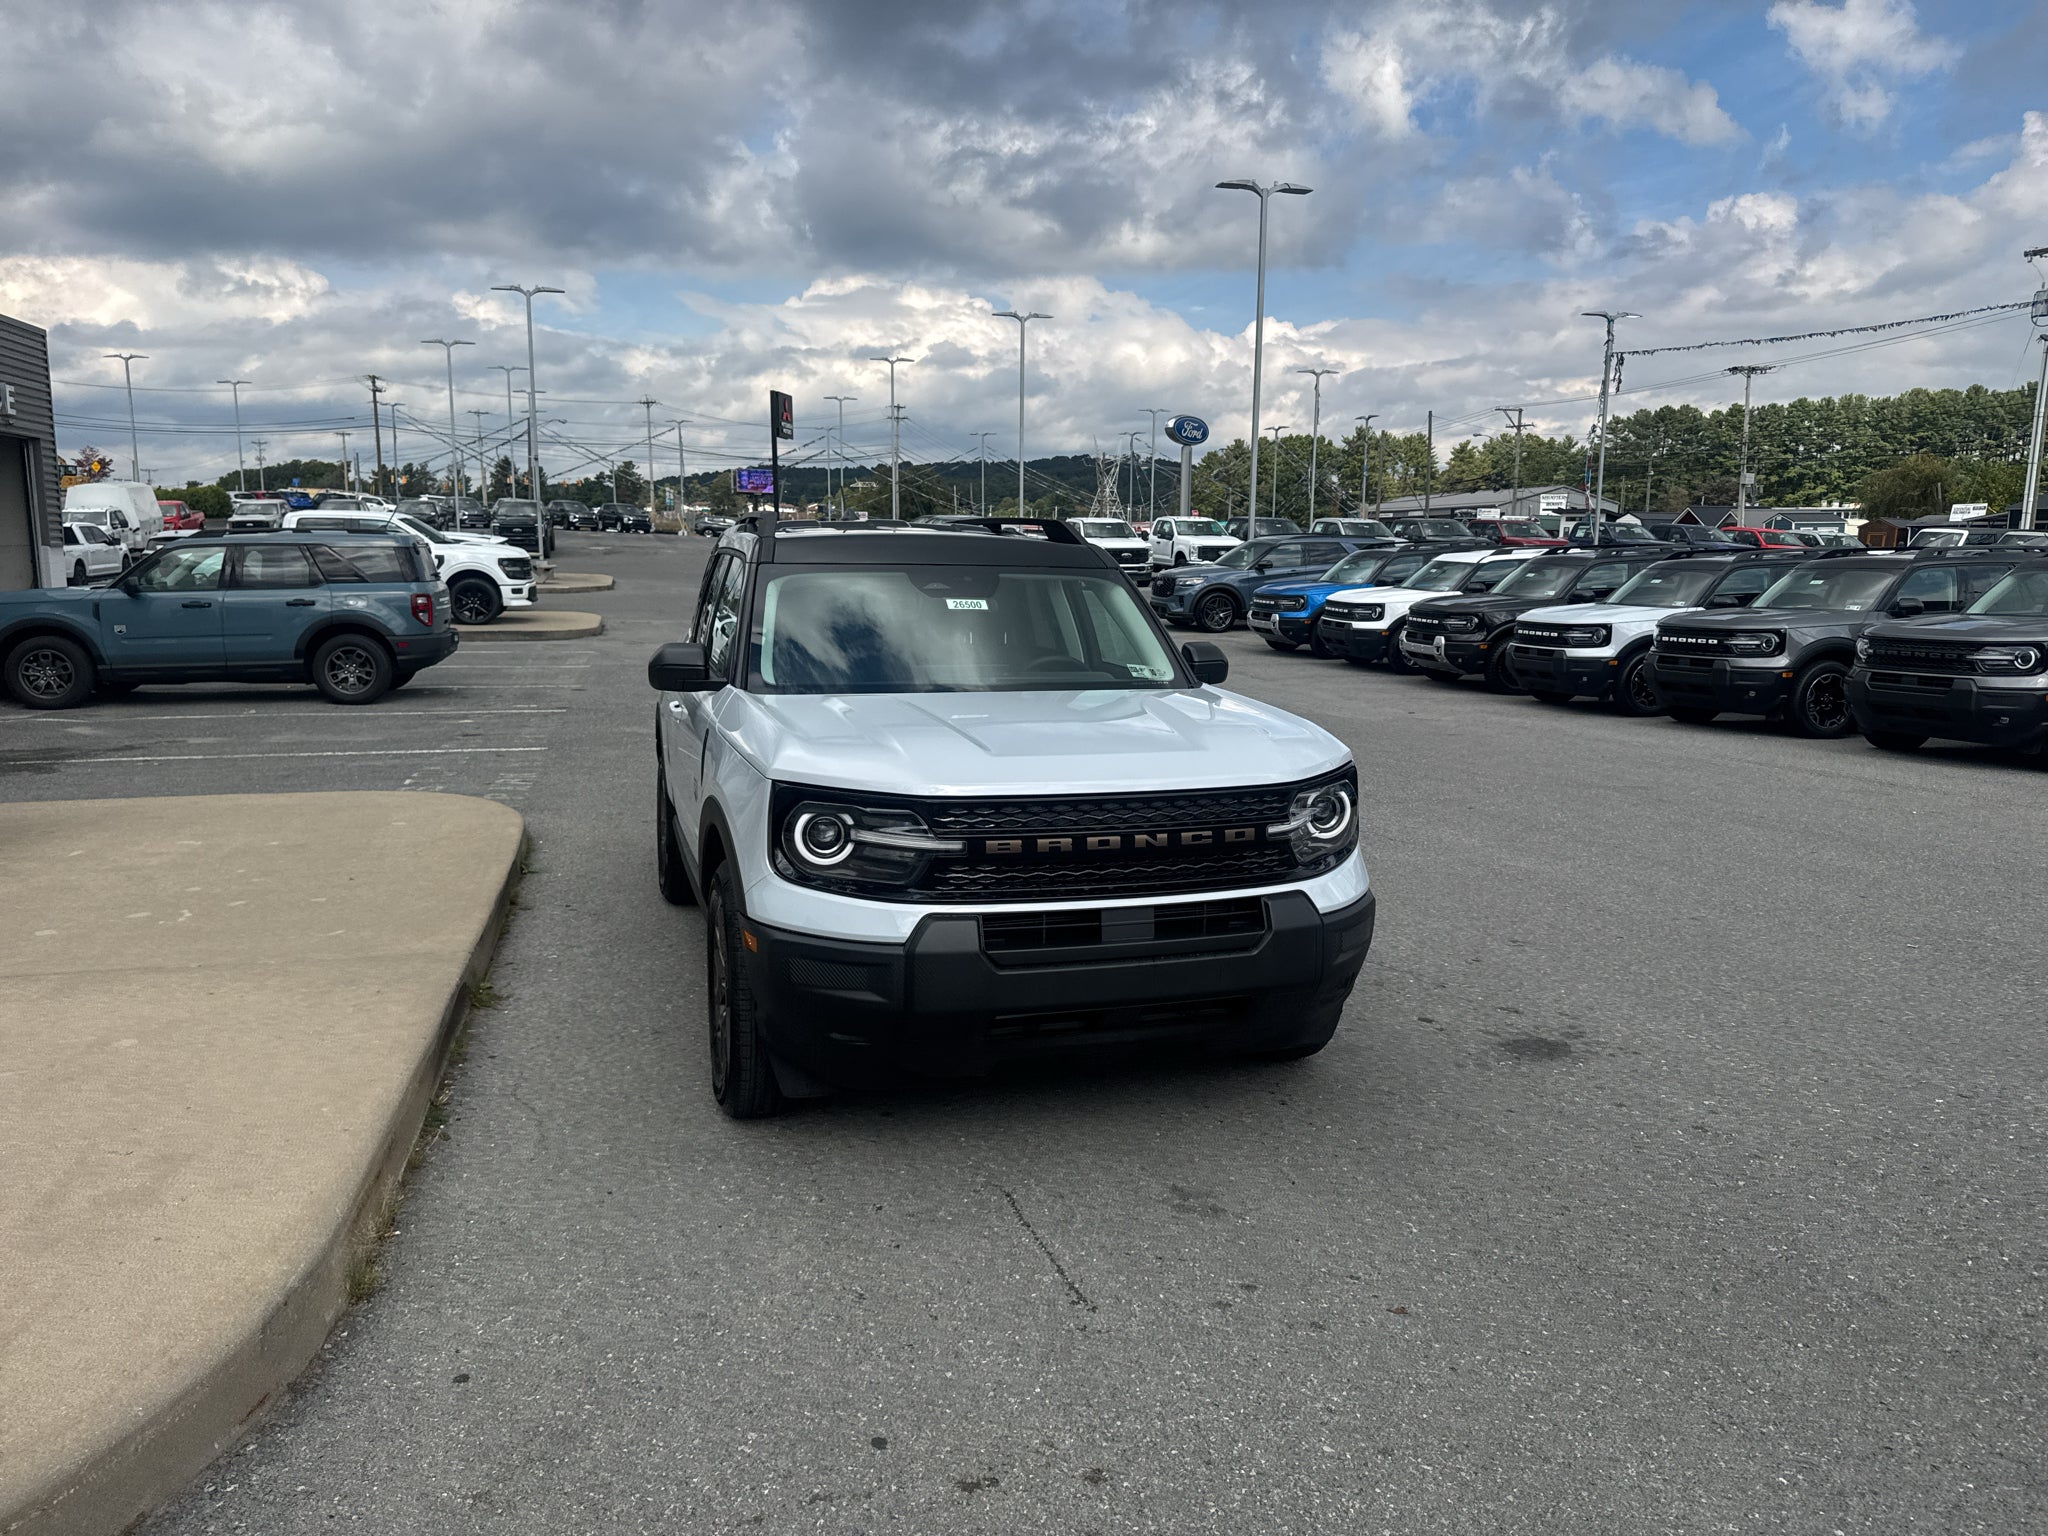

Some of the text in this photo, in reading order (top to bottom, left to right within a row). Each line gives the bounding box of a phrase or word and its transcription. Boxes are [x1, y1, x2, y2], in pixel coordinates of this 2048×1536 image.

[1181, 420, 1204, 439] Ford
[952, 600, 982, 609] 26500
[1517, 629, 1558, 637] BRONCO
[1661, 636, 1718, 644] BRONCO
[985, 827, 1256, 854] BRONCO
